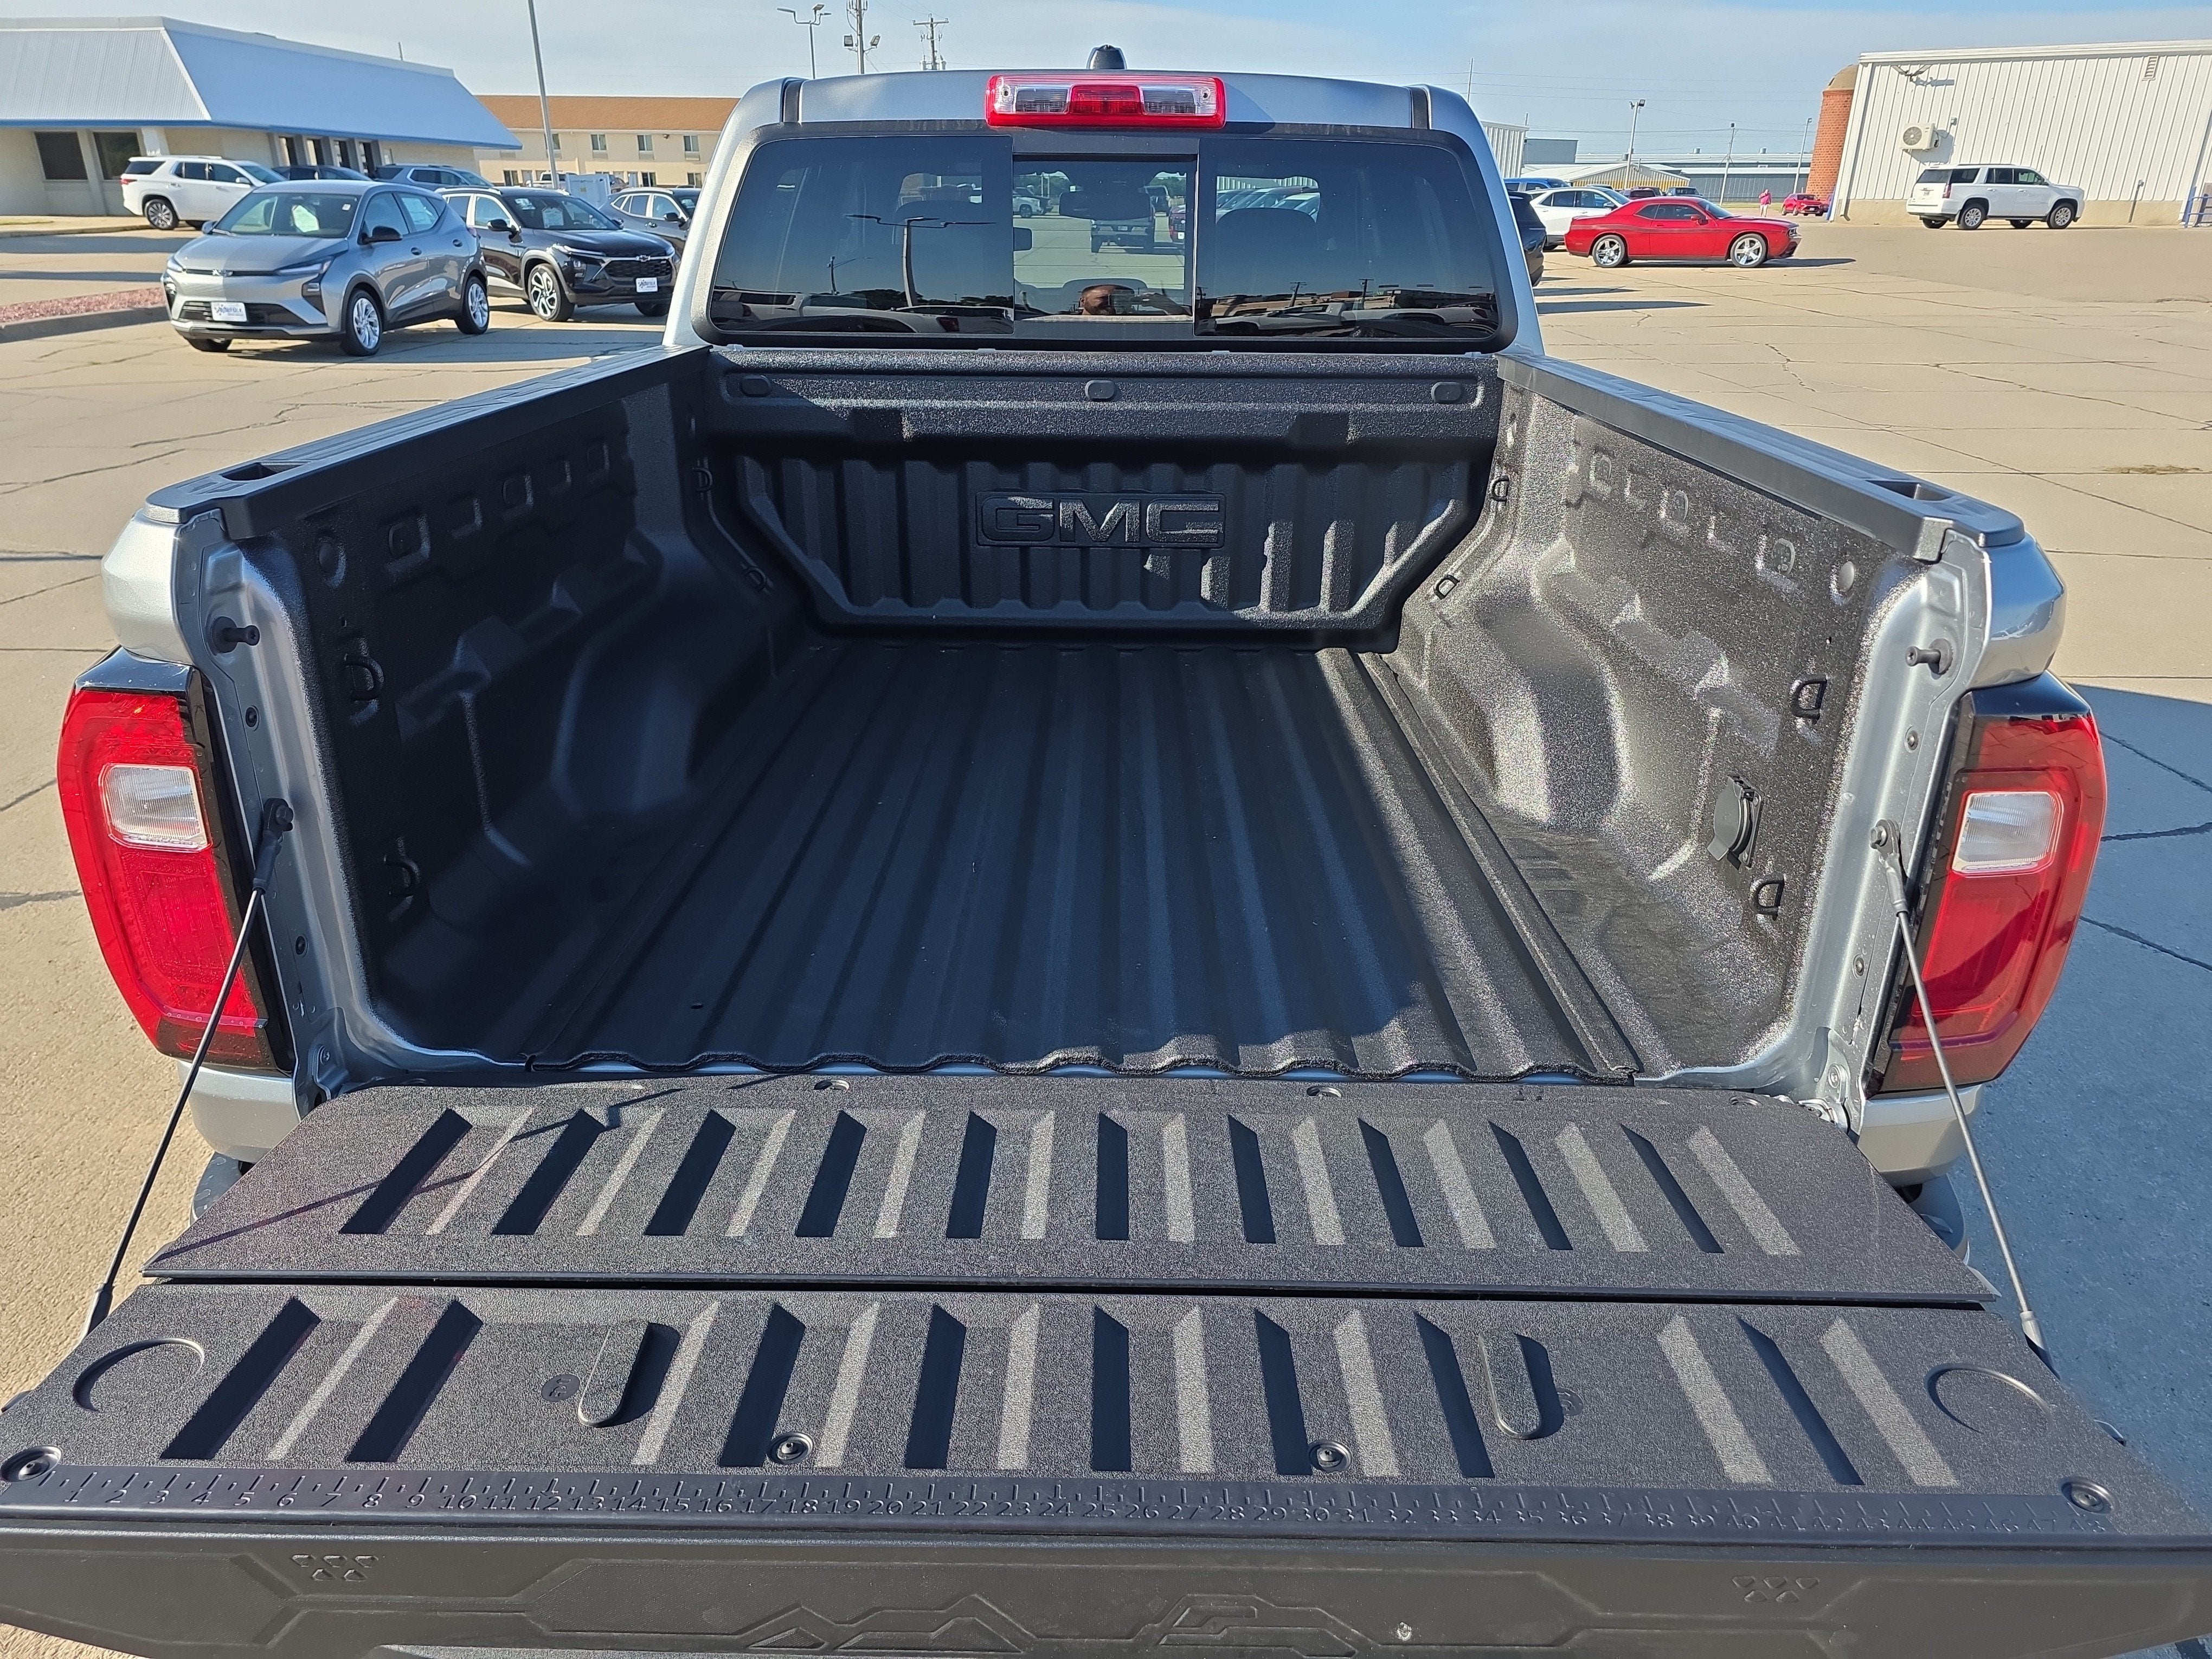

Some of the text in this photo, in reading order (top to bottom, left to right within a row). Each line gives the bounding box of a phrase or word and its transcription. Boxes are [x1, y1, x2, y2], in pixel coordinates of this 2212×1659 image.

[981, 496, 1220, 543] GMC
[63, 1488, 83, 1503] 1
[105, 1489, 127, 1503] 2
[148, 1490, 169, 1504] 3
[192, 1491, 212, 1505] 4
[234, 1491, 255, 1506] 5
[277, 1492, 298, 1507] 6
[321, 1493, 342, 1507] 7
[361, 1493, 383, 1508] 8
[405, 1494, 425, 1508] 9
[439, 1494, 477, 1510] 10
[481, 1495, 516, 1510] 11
[525, 1495, 562, 1511] 12
[568, 1496, 604, 1512] 13
[610, 1496, 647, 1512] 14
[653, 1497, 690, 1513] 15
[696, 1498, 732, 1513] 16
[739, 1499, 777, 1513] 17
[783, 1499, 818, 1514] 18
[826, 1499, 861, 1514] 19
[867, 1500, 904, 1515] 20
[911, 1501, 945, 1515] 21
[954, 1501, 989, 1516] 22
[996, 1501, 1031, 1516] 23
[1038, 1502, 1073, 1516] 24
[1083, 1503, 1117, 1517] 25
[1124, 1503, 1160, 1519] 26
[1168, 1504, 1204, 1520] 27
[1211, 1506, 1246, 1520] 28
[1253, 1506, 1288, 1521] 29
[1296, 1507, 1330, 1522] 30
[1338, 1508, 1374, 1523] 31
[1383, 1508, 1417, 1523] 32
[1425, 1509, 1460, 1524] 33
[1467, 1510, 1502, 1525] 34
